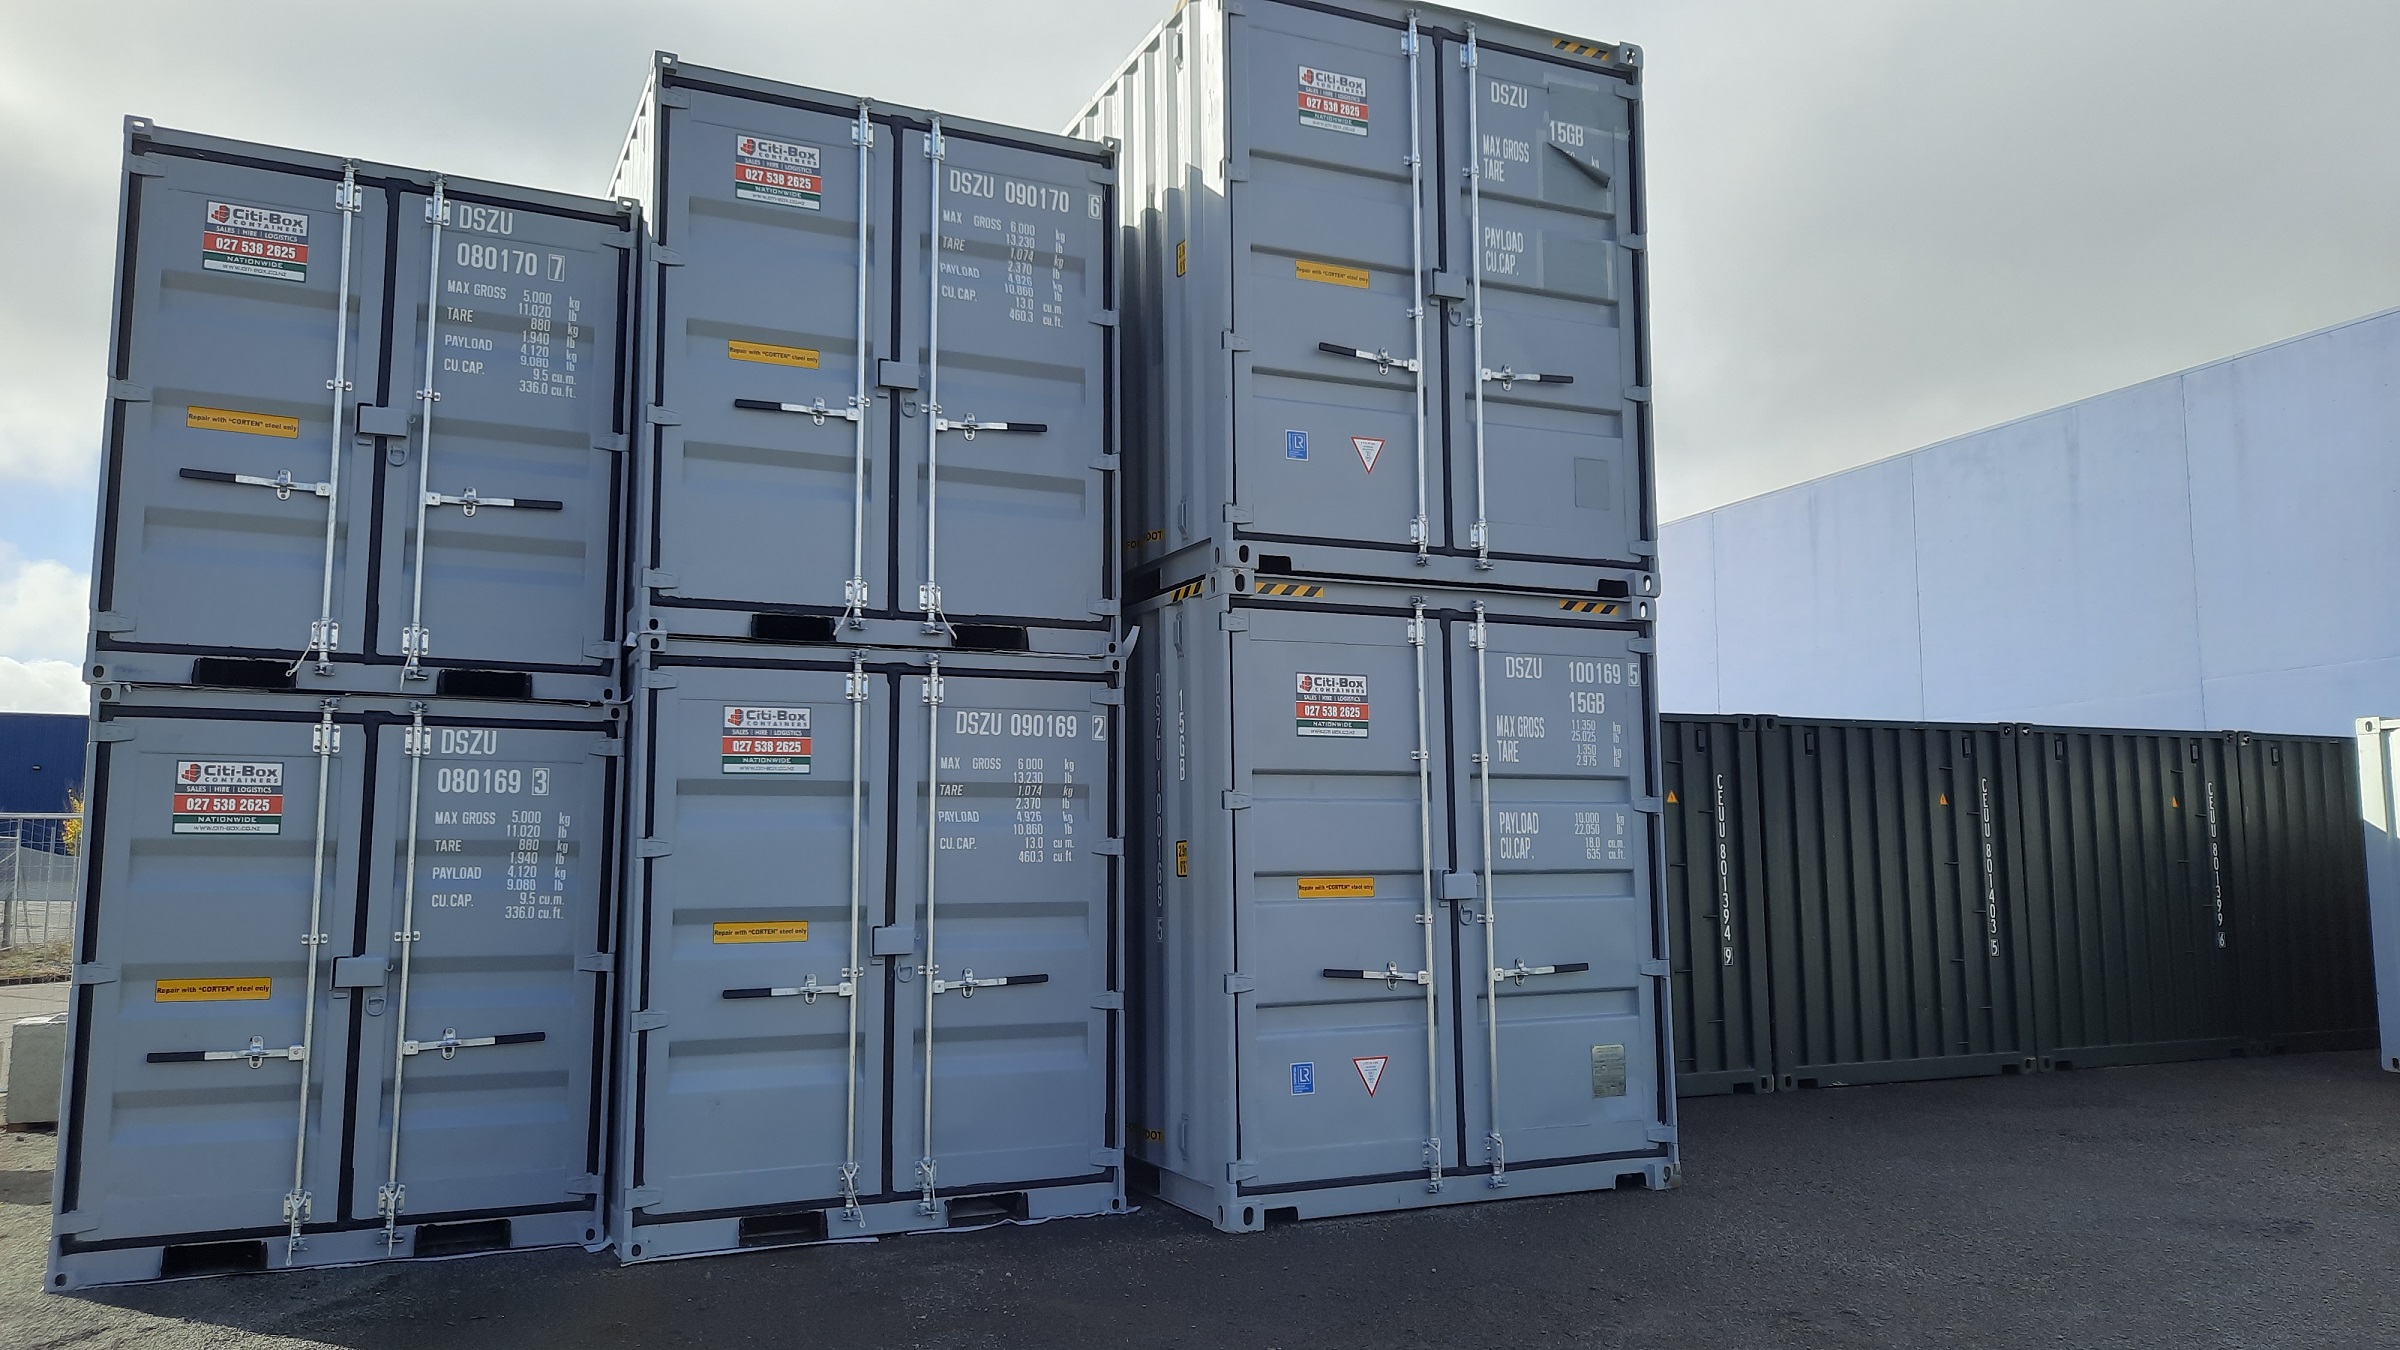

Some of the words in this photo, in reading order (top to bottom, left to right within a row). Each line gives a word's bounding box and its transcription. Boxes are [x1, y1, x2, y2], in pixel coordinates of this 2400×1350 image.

[1316, 72, 1363, 90] Citi-Box
[1490, 82, 1528, 109] DSZU
[1550, 120, 1584, 147] 15GB
[758, 141, 816, 160] Citi-Box
[1483, 134, 1500, 158] MAX
[1502, 136, 1530, 163] GROSS
[759, 153, 817, 166] CONTAINERS
[1484, 158, 1505, 182] TARE
[746, 168, 763, 181] 027
[767, 172, 784, 185] 538
[787, 176, 811, 189] 2625
[950, 169, 994, 199] DSZU
[1005, 182, 1070, 213] 090170
[1090, 195, 1101, 218] 6
[233, 208, 303, 228] Citi-Box
[459, 205, 513, 235] DSZU
[942, 210, 963, 225] MAX
[974, 215, 1002, 231] GROSS
[1010, 222, 1036, 236] 6.000
[234, 220, 303, 234] CONTAINERS
[242, 229, 257, 237] HIRE
[265, 233, 298, 242] LOGISTICS
[1006, 234, 1035, 249] 13.230
[1485, 227, 1524, 253] PAYLOAD
[216, 237, 238, 251] 027
[241, 241, 263, 254] 538
[267, 245, 296, 259] 2625
[942, 236, 965, 252] TARE
[1010, 248, 1034, 262] 1.074
[227, 256, 283, 269] NATIONWIDE
[457, 243, 538, 276] 080170
[549, 255, 564, 281] 7
[1007, 261, 1032, 276] 2.370
[940, 263, 980, 279] PAYLOAD
[447, 280, 470, 294] MAX
[474, 283, 506, 300] GROSS
[523, 290, 552, 305] 5.000
[569, 296, 580, 311] kg
[941, 285, 977, 302] CU.CAP.
[519, 303, 552, 318] 11.020
[568, 310, 577, 322] lb
[447, 307, 473, 322] TARE
[531, 318, 550, 331] 880
[568, 322, 579, 338] kg
[522, 330, 550, 345] 1.940
[567, 337, 575, 349] lb
[445, 334, 493, 351] PAYLOAD
[520, 344, 549, 357] 4.120
[566, 350, 577, 363] kg
[444, 358, 485, 375] CU.CAP.
[533, 369, 548, 381] 9.5
[551, 373, 576, 385] cu.m.
[520, 356, 549, 368] 9.080
[566, 362, 574, 372] lb
[519, 380, 548, 394] 336.0
[551, 386, 576, 399] cu.ft.
[189, 413, 210, 421] Repair
[1506, 657, 1542, 679] DSZU
[1569, 661, 1621, 685] 100169
[1629, 664, 1638, 686] 5
[1314, 677, 1363, 688] Citi-Box
[1569, 691, 1605, 714] 15GB
[746, 710, 806, 721] Citi-Box
[1305, 705, 1320, 716] 027
[1323, 706, 1337, 716] 538
[1340, 707, 1360, 717] 2625
[956, 711, 1002, 736] DSZU
[1010, 713, 1077, 738] 090169
[1093, 716, 1105, 740] 2
[1496, 715, 1515, 737] MAX
[1518, 716, 1545, 738] GROSS
[1572, 720, 1595, 730] 11.350
[441, 729, 497, 755] DSZU
[1178, 689, 1186, 781] 15GB
[1572, 731, 1596, 742] 25.025
[733, 740, 752, 752] 027
[755, 741, 773, 752] 538
[776, 741, 801, 752] 2625
[1497, 740, 1519, 763] TARE
[940, 757, 960, 770] MAX
[972, 758, 1001, 770] GROSS
[1576, 755, 1597, 767] 2.975
[204, 764, 278, 777] Citi-Box
[1014, 772, 1043, 784] 13.230
[437, 768, 521, 793] 080169
[533, 769, 548, 794] 3
[939, 785, 963, 796] TARE
[1017, 785, 1042, 796] 1.074
[186, 798, 210, 811] 027
[213, 799, 236, 811] 538
[240, 799, 270, 811] 2625
[1016, 798, 1041, 810] 2.370
[1716, 773, 1726, 838] CEUU
[435, 811, 458, 825] MAX
[462, 812, 496, 825] GROSS
[511, 811, 542, 824] 5.000
[938, 811, 980, 823] PAYLOAD
[1017, 811, 1042, 822] 4.926
[1500, 812, 1539, 835] PAYLOAD
[1575, 812, 1599, 823] 10.000
[506, 825, 541, 838] 11.020
[1014, 824, 1043, 835] 10.860
[1575, 824, 1600, 835] 22.050
[434, 840, 462, 852] TARE
[519, 839, 539, 851] 880
[1025, 837, 1043, 849] 13.0
[1585, 837, 1600, 848] 18.0
[510, 852, 538, 865] 1.940
[1018, 851, 1043, 863] 460.3
[1587, 849, 1601, 860] 635
[2207, 782, 2217, 838] CEUU
[2213, 842, 2223, 926] 801399
[432, 867, 482, 880] PAYLOAD
[507, 866, 537, 878] 4.120
[1981, 777, 1991, 838] CEUU
[1986, 843, 1997, 934] 801403
[1992, 940, 1999, 956] 5
[506, 879, 536, 891] 9.080
[1720, 843, 1731, 941] 801394
[431, 894, 473, 907] CU.CAP.
[519, 893, 536, 905] 9.5
[505, 906, 534, 919] 336.0
[1724, 947, 1732, 965] 9
[255, 985, 269, 993] only
